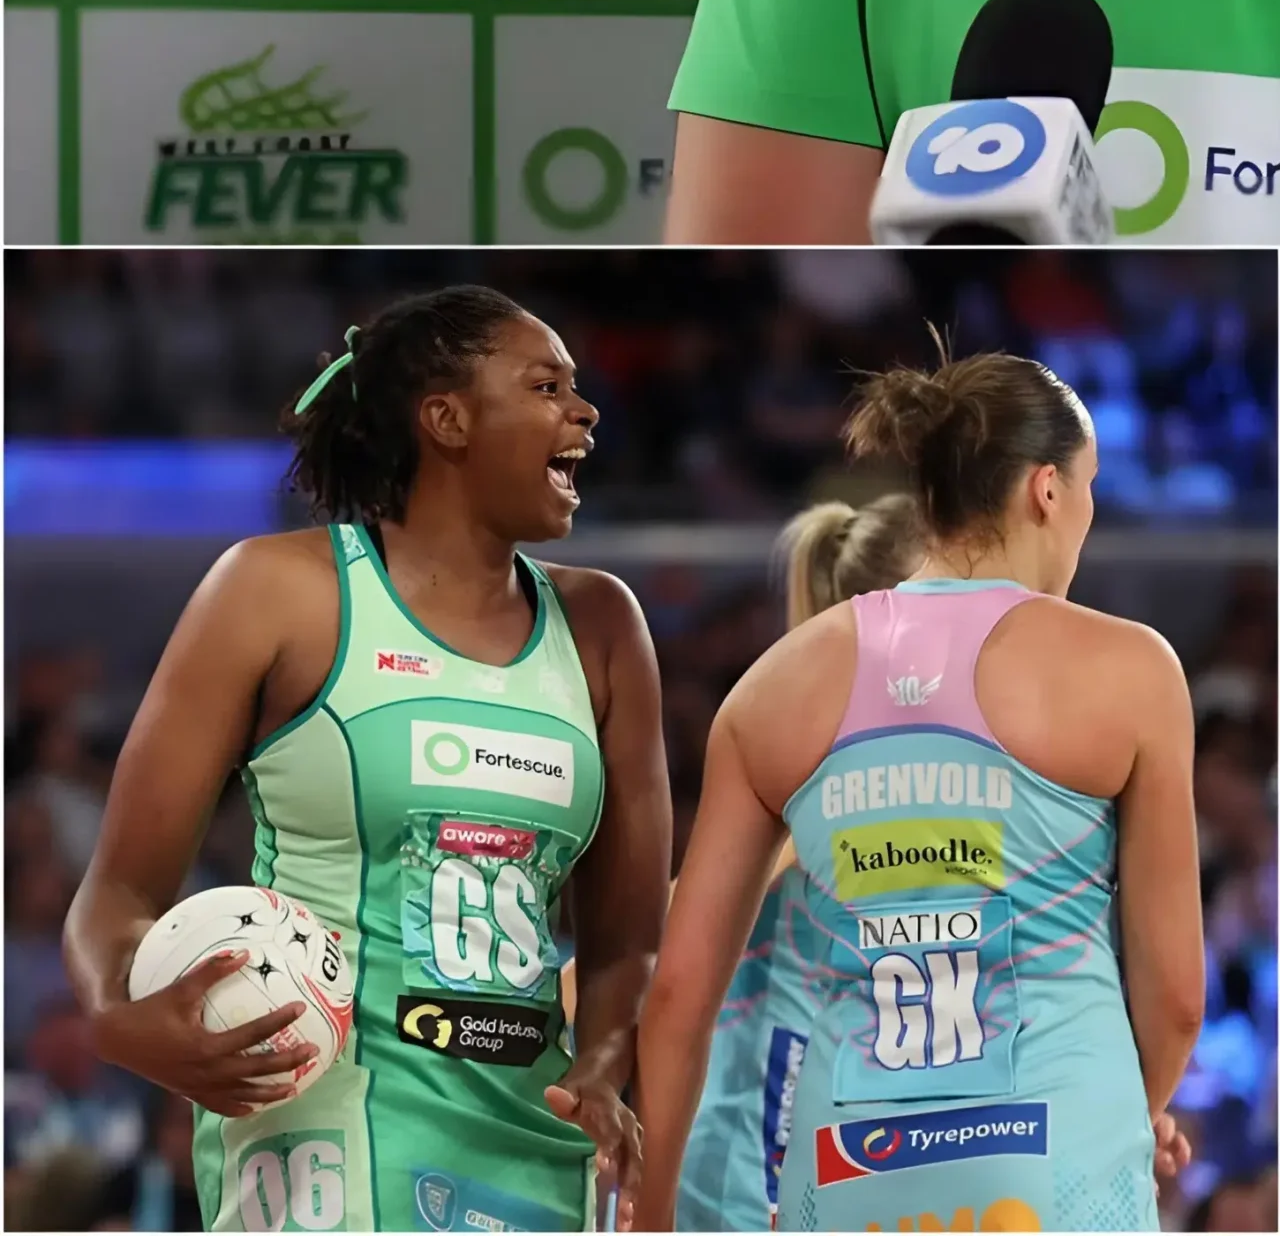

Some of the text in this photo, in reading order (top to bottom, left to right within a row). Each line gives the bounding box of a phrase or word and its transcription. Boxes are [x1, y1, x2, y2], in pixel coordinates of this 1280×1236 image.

[144, 149, 408, 231] FEVER
[822, 762, 1012, 819] GRENVOLD
[430, 858, 544, 989] GS
[861, 912, 978, 947] NATIO
[460, 1016, 497, 1033] Gold
[460, 1030, 504, 1052] Group
[908, 1117, 1038, 1150] Tyrepower
[240, 1140, 346, 1232] 06
